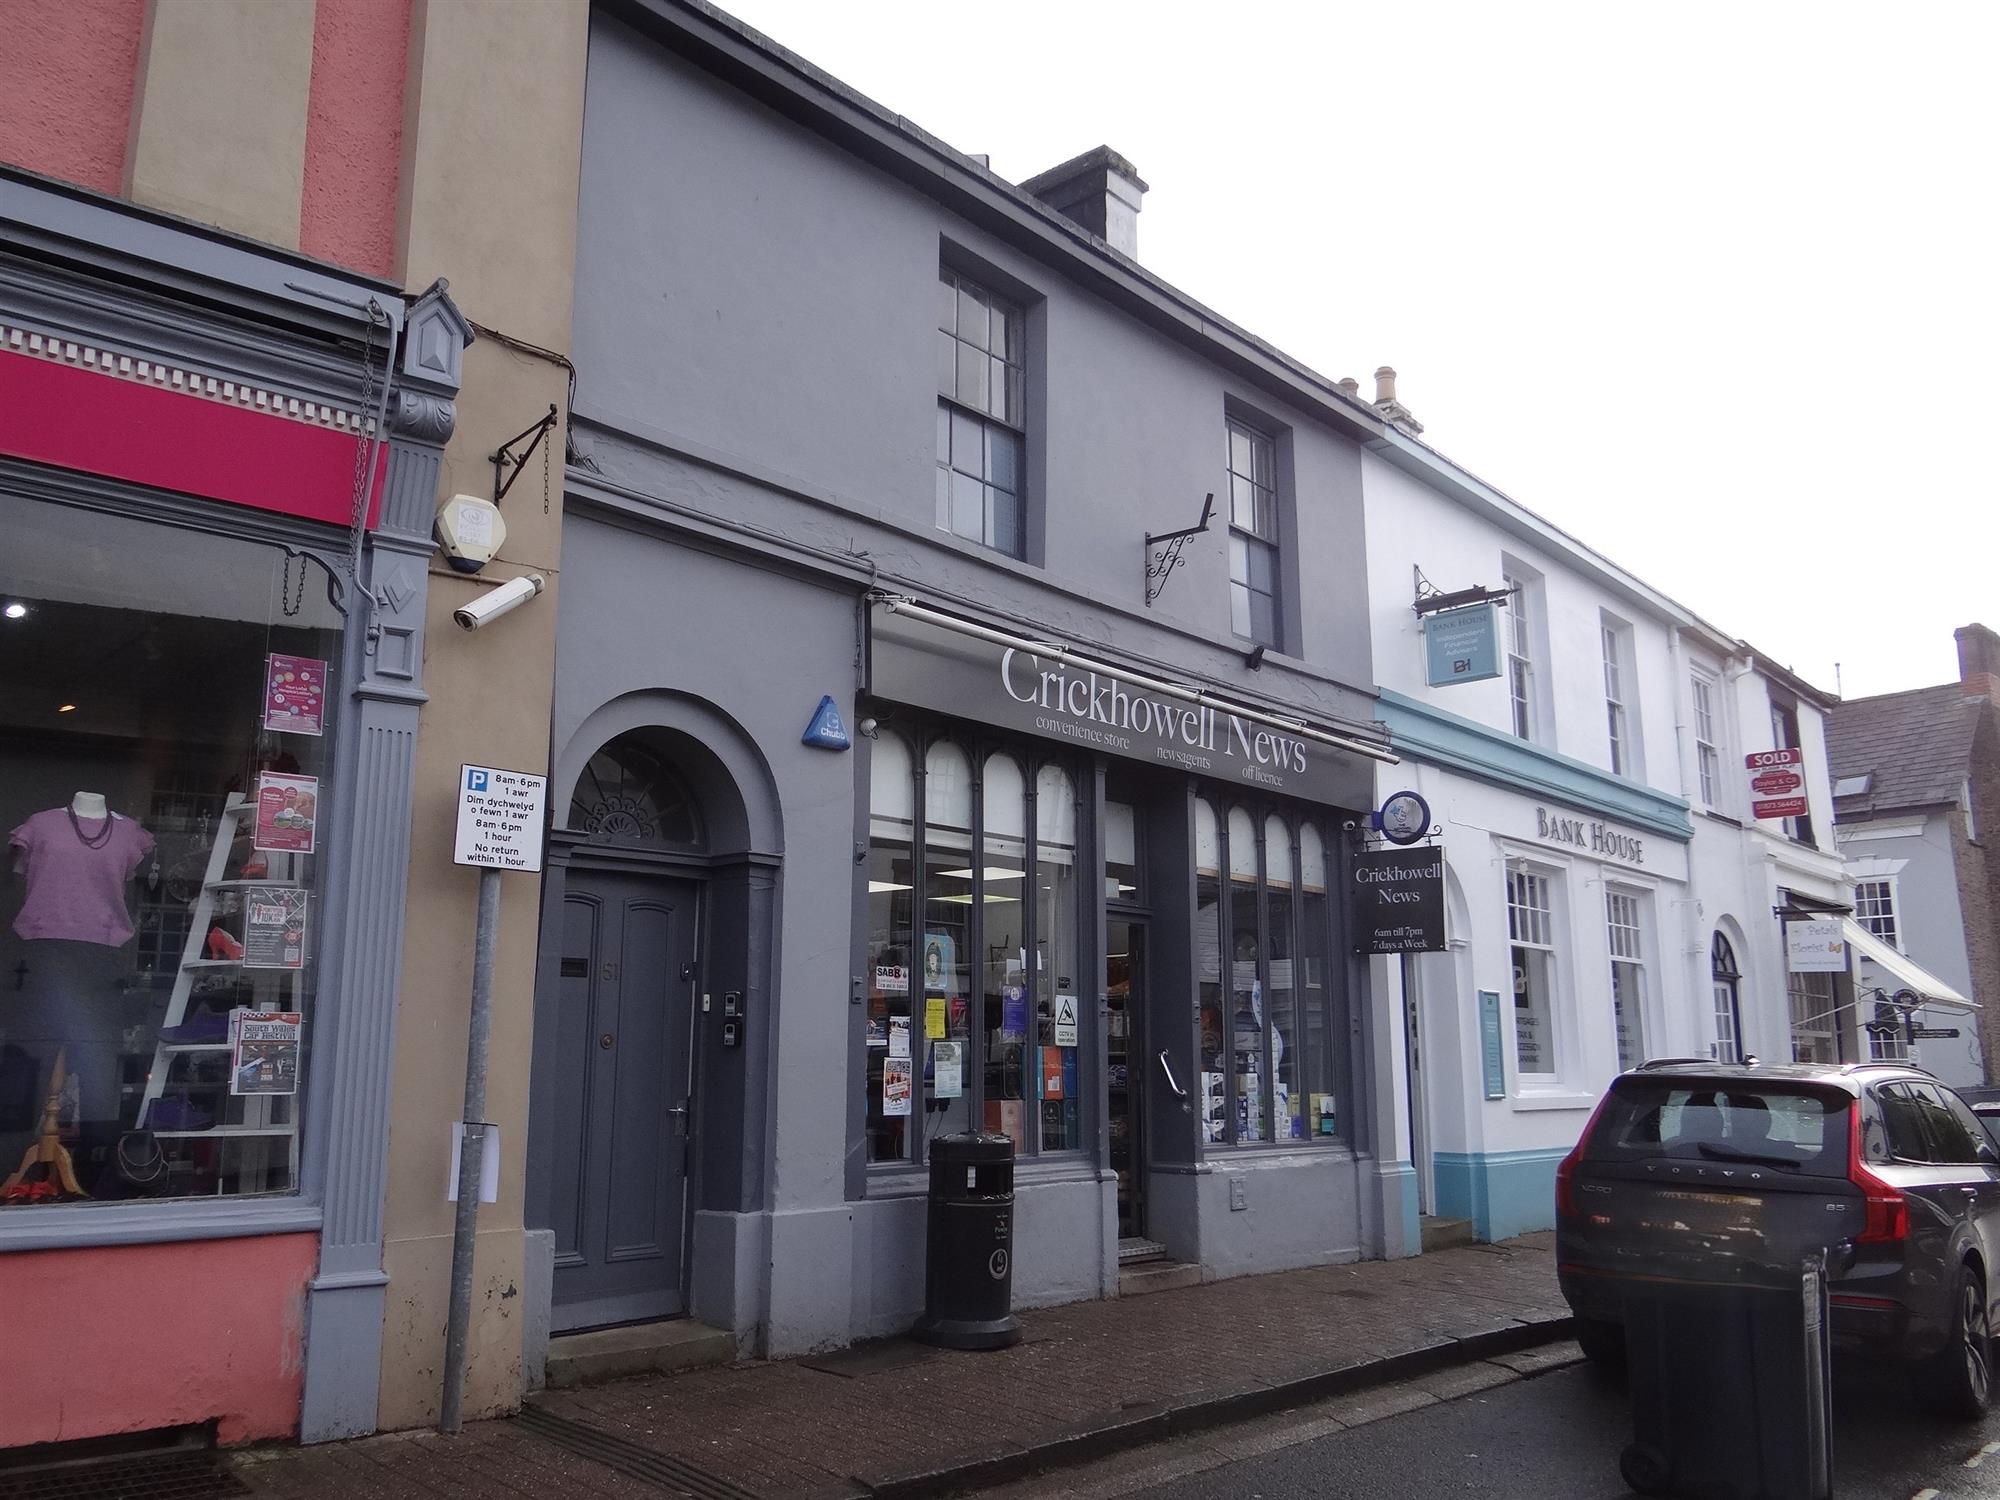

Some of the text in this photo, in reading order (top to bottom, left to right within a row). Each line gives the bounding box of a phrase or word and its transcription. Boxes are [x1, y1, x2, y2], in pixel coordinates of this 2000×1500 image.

[1001, 647, 1307, 773] Crickhowell News
[820, 727, 847, 740] Chubb
[1036, 715, 1130, 750] convenience store
[1156, 745, 1211, 770] newsagents
[1754, 751, 1791, 766] SOLD
[471, 772, 485, 789] P
[505, 787, 529, 798] 1 awr
[466, 795, 534, 812] Dim dychwelyd
[480, 806, 502, 816] fewn
[512, 812, 529, 820] awr
[492, 832, 512, 842] hour
[1536, 806, 1644, 865] BANK HOUSE
[475, 843, 519, 856] No return
[467, 853, 525, 866] within 1 hour
[1355, 862, 1441, 884] Crickhowell
[1378, 888, 1421, 905] News
[1374, 927, 1423, 938] 6am till 7pm
[1372, 941, 1377, 949] 7
[1378, 941, 1398, 951] days
[1404, 939, 1428, 949] Week
[244, 1032, 296, 1040] Car Festival
[1647, 1165, 1761, 1180] VOLVO
[1826, 1203, 1846, 1211] B5
